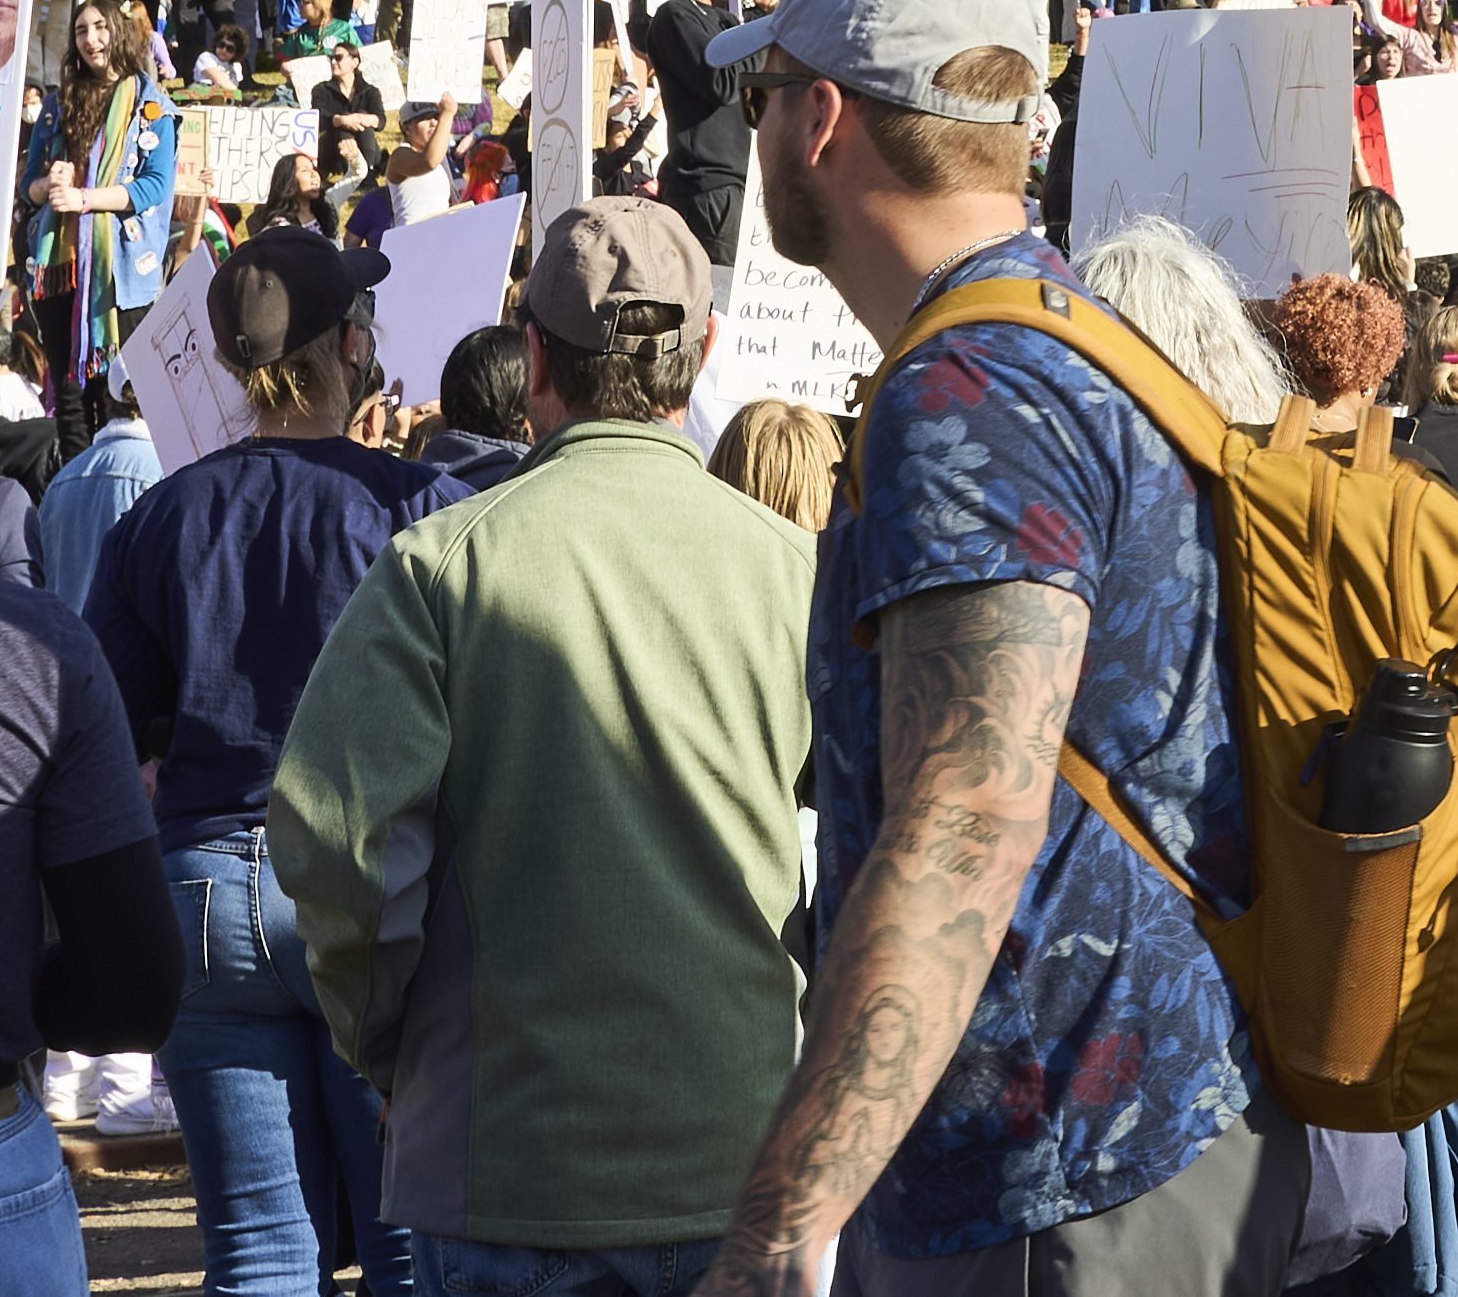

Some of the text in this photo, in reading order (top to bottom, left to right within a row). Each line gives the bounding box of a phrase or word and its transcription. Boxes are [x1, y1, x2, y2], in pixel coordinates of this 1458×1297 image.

[1103, 28, 1325, 172] VIVA
[209, 108, 290, 136] ELPING
[211, 136, 288, 165] THERS
[212, 170, 253, 202] ELPS
[744, 261, 835, 289] becom
[739, 301, 813, 323] about
[735, 336, 882, 368] that Matte
